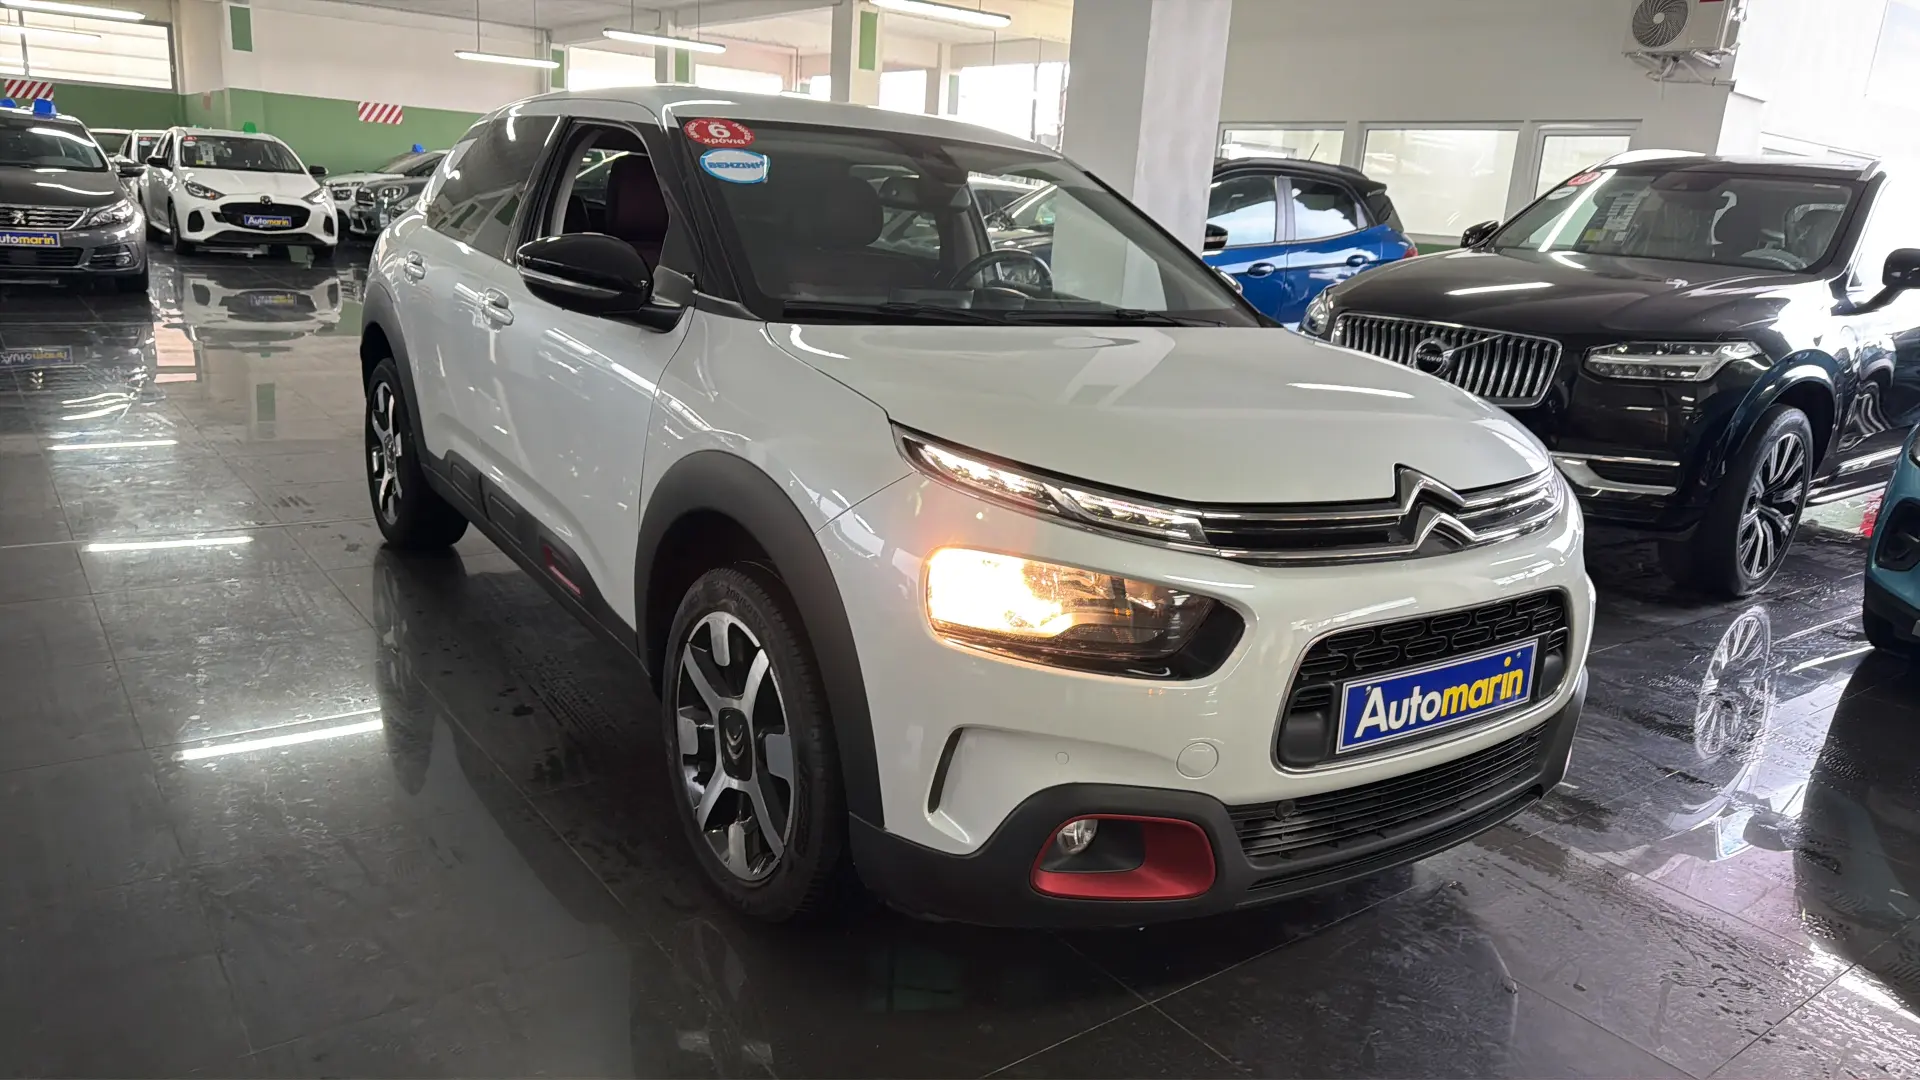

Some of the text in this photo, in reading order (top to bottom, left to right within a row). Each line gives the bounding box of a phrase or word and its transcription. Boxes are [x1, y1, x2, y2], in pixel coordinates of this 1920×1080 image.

[708, 124, 731, 138] 6
[703, 137, 746, 145] χρόνια
[248, 216, 289, 226] Automarin
[0, 233, 55, 245] utomarin
[1354, 656, 1524, 738] Automarin
